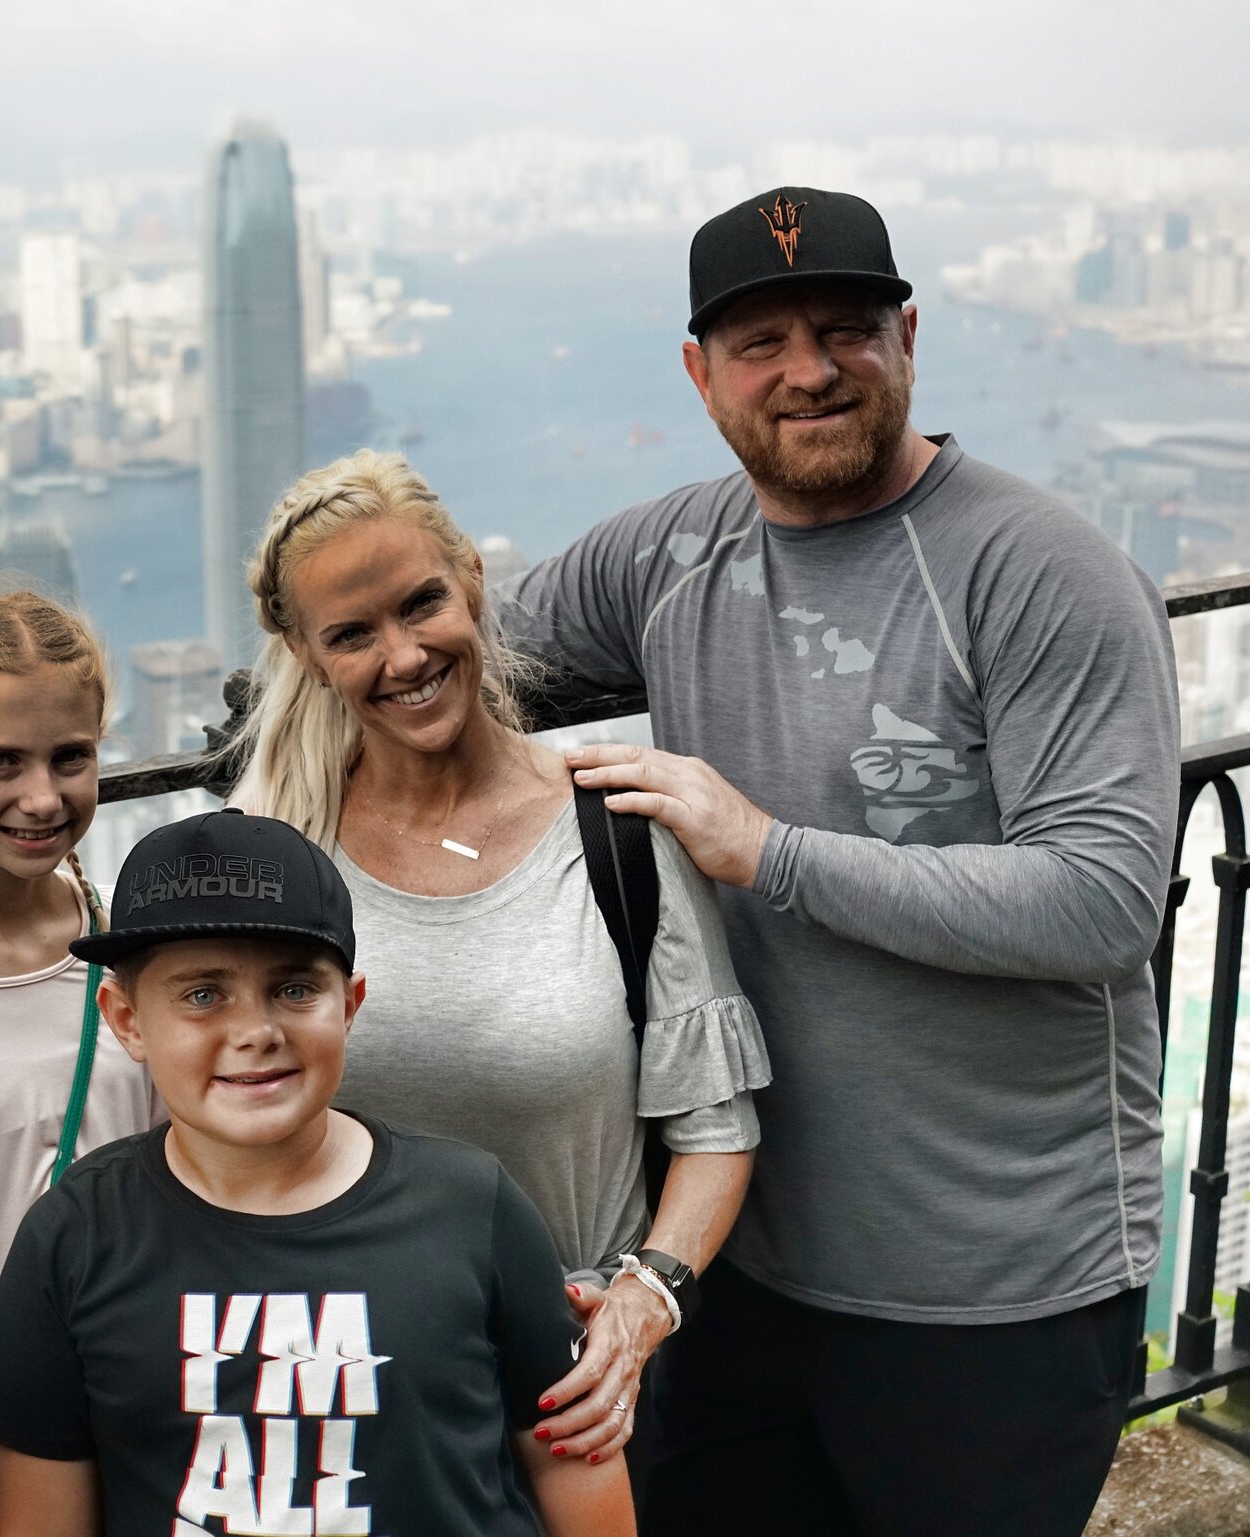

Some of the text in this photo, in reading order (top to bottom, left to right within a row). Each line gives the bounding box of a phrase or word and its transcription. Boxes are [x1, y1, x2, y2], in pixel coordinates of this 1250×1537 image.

[127, 876, 284, 919] ARMOUR
[130, 853, 284, 896] UNDER
[180, 1292, 393, 1416] I'M
[176, 1414, 372, 1535] ALL
